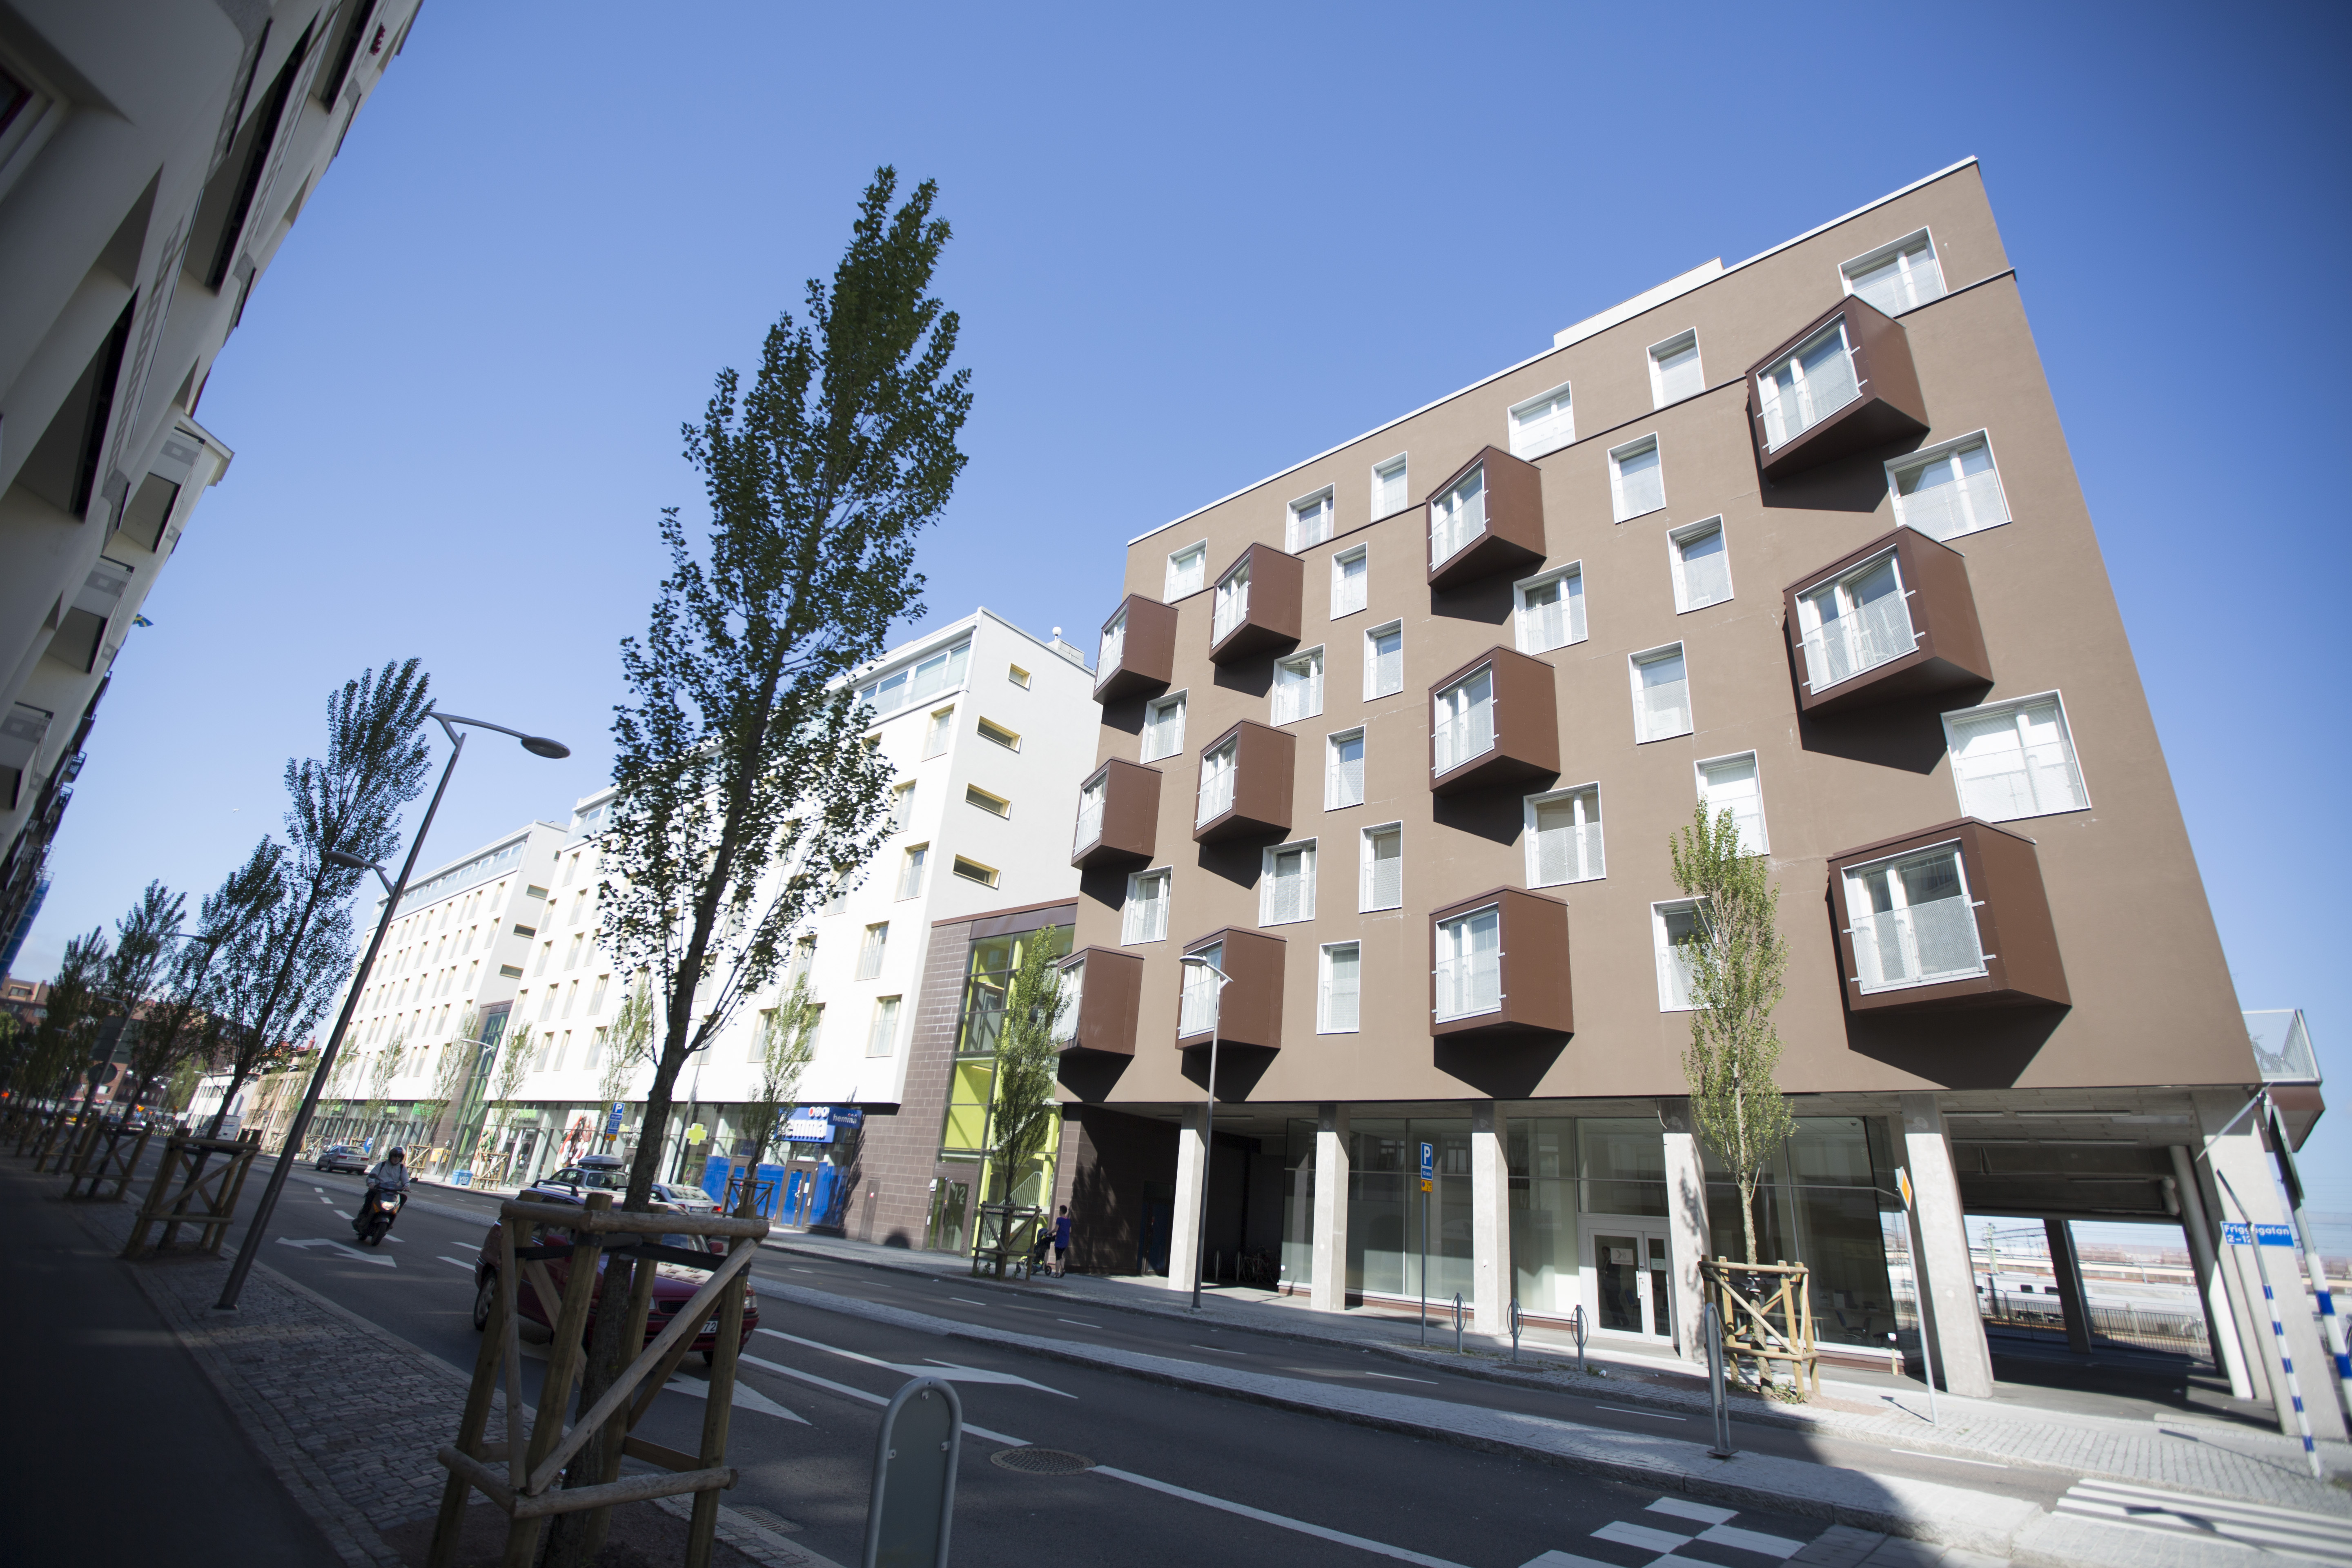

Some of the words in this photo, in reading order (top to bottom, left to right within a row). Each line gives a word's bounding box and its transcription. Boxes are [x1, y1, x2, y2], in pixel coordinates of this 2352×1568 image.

[615, 1103, 623, 1113] P
[833, 1114, 857, 1124] hemma
[1424, 1145, 1431, 1165] P
[953, 1186, 966, 1200] 12
